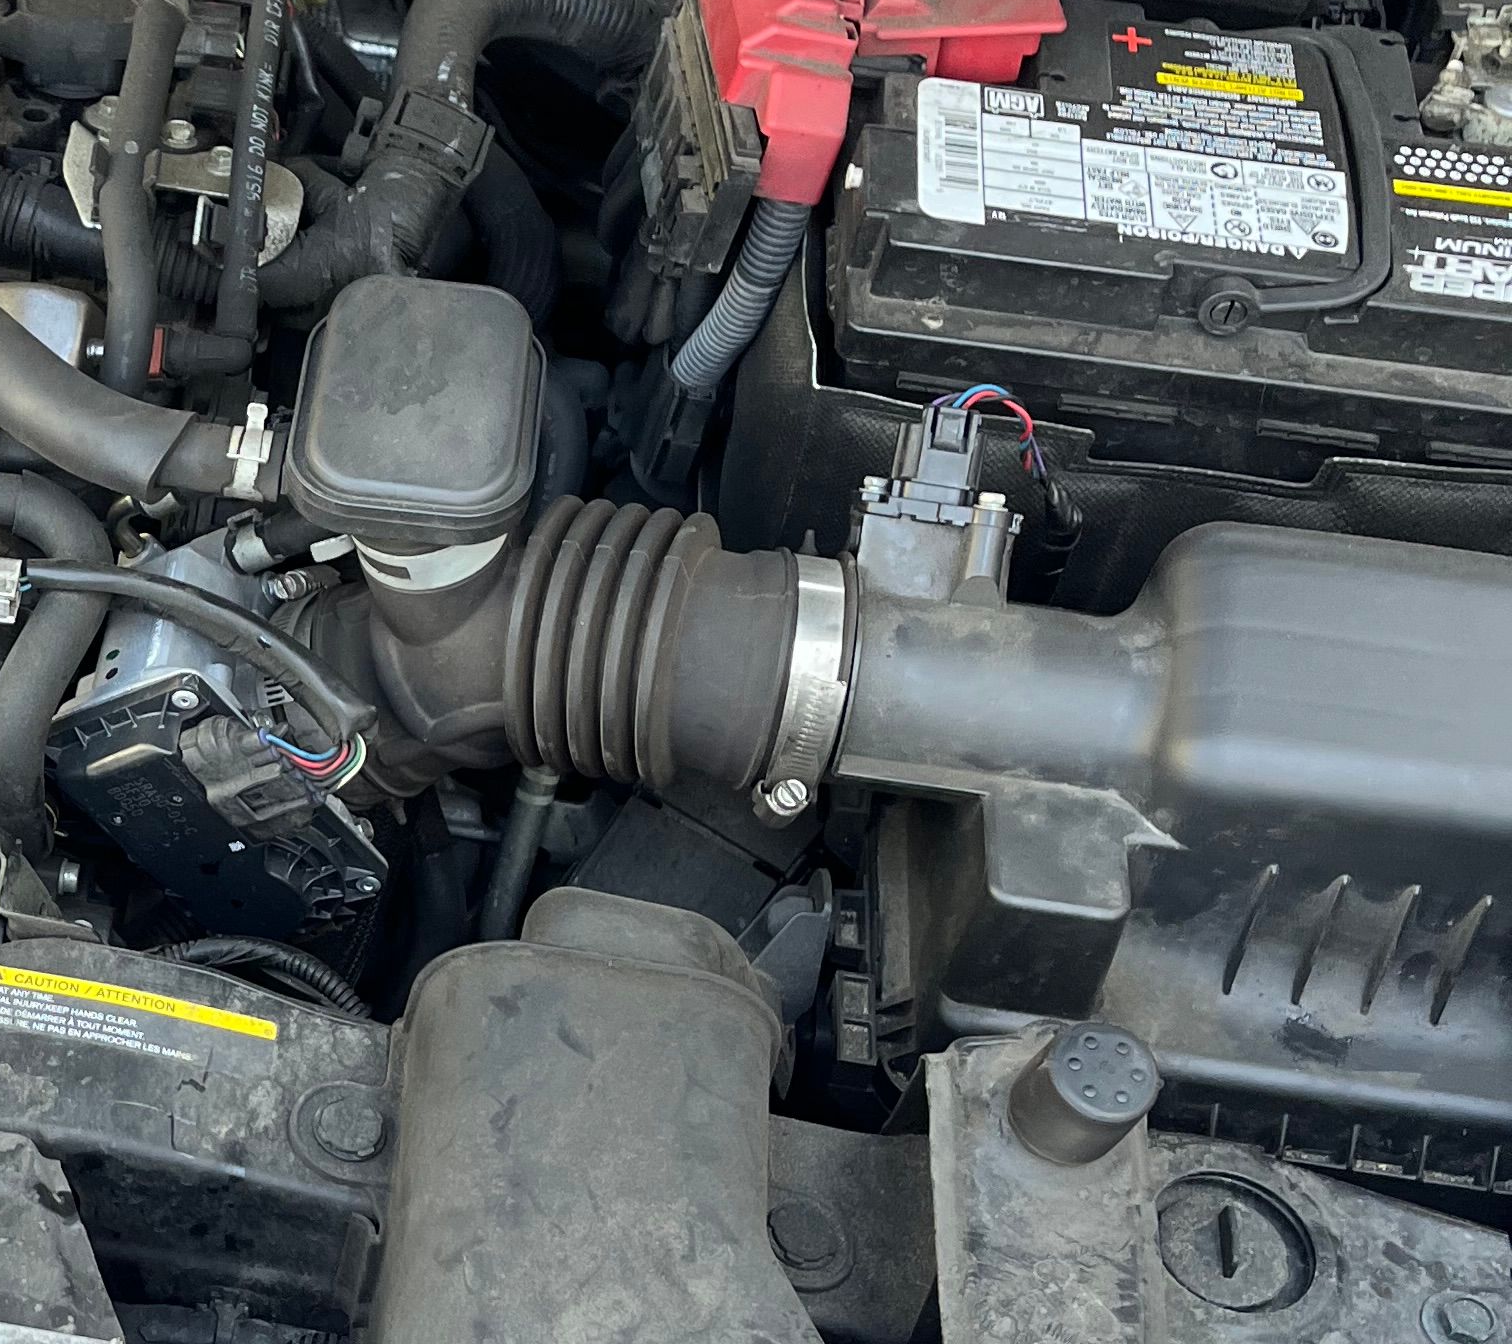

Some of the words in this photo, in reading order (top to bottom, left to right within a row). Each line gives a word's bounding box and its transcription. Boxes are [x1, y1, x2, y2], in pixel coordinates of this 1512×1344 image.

[989, 90, 1040, 113] AGM
[1117, 223, 1286, 257] DANGER/POISON
[10, 988, 31, 999] ANY
[14, 973, 80, 993] CAUTION
[95, 987, 177, 1014] ATTENTION
[0, 1006, 14, 1017] DE
[75, 1019, 102, 1032] TOUT
[70, 1008, 105, 1022] HANDS
[31, 1022, 48, 1033] NE
[47, 1025, 67, 1036] PAS
[67, 1027, 82, 1039] EN
[81, 1031, 143, 1051] APPROCHER
[142, 1043, 162, 1055] LES
